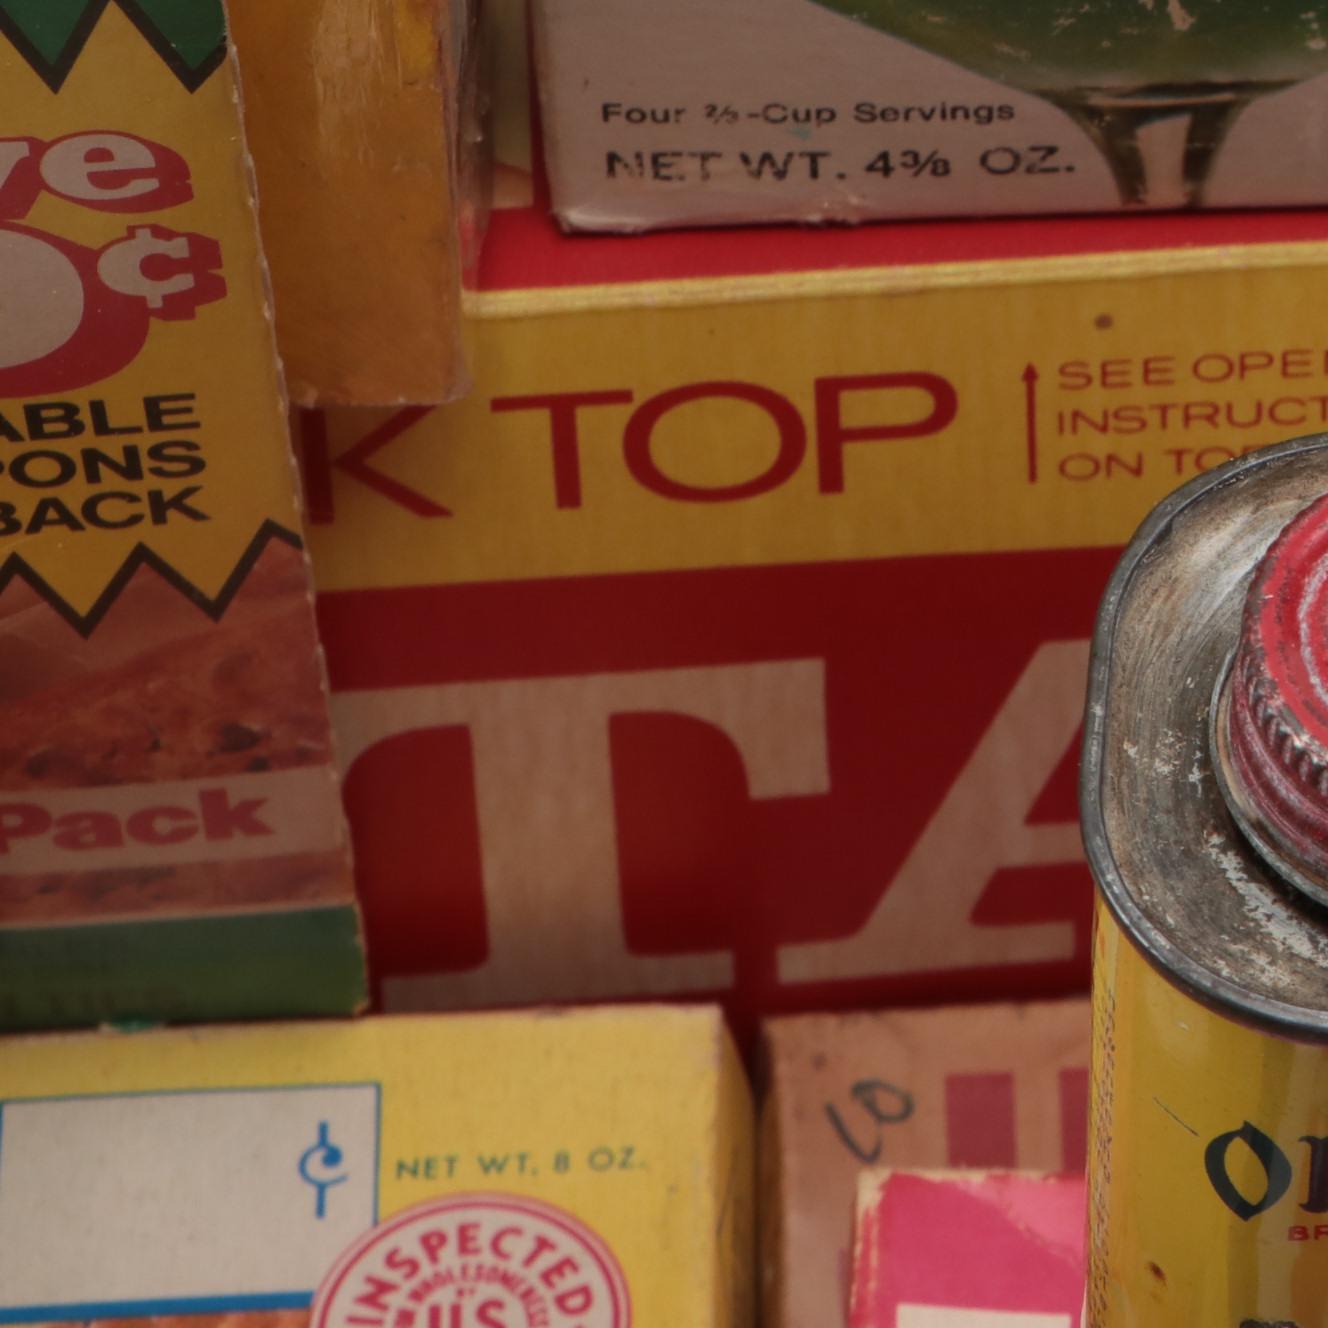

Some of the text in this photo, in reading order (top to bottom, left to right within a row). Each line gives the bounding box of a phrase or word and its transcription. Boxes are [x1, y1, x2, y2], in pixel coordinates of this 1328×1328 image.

[602, 101, 686, 125] Four
[854, 100, 1015, 125] Servings
[606, 150, 722, 182] NET
[741, 149, 848, 181] WT.
[979, 144, 1076, 176] OZ.
[1058, 356, 1176, 390] SEE
[490, 371, 959, 510] TOP
[0, 440, 207, 487] ONS
[1058, 452, 1144, 483] ON
[395, 1144, 648, 1180] NET WT. 8 OZ.
[344, 1221, 597, 1328] INSPECTED
